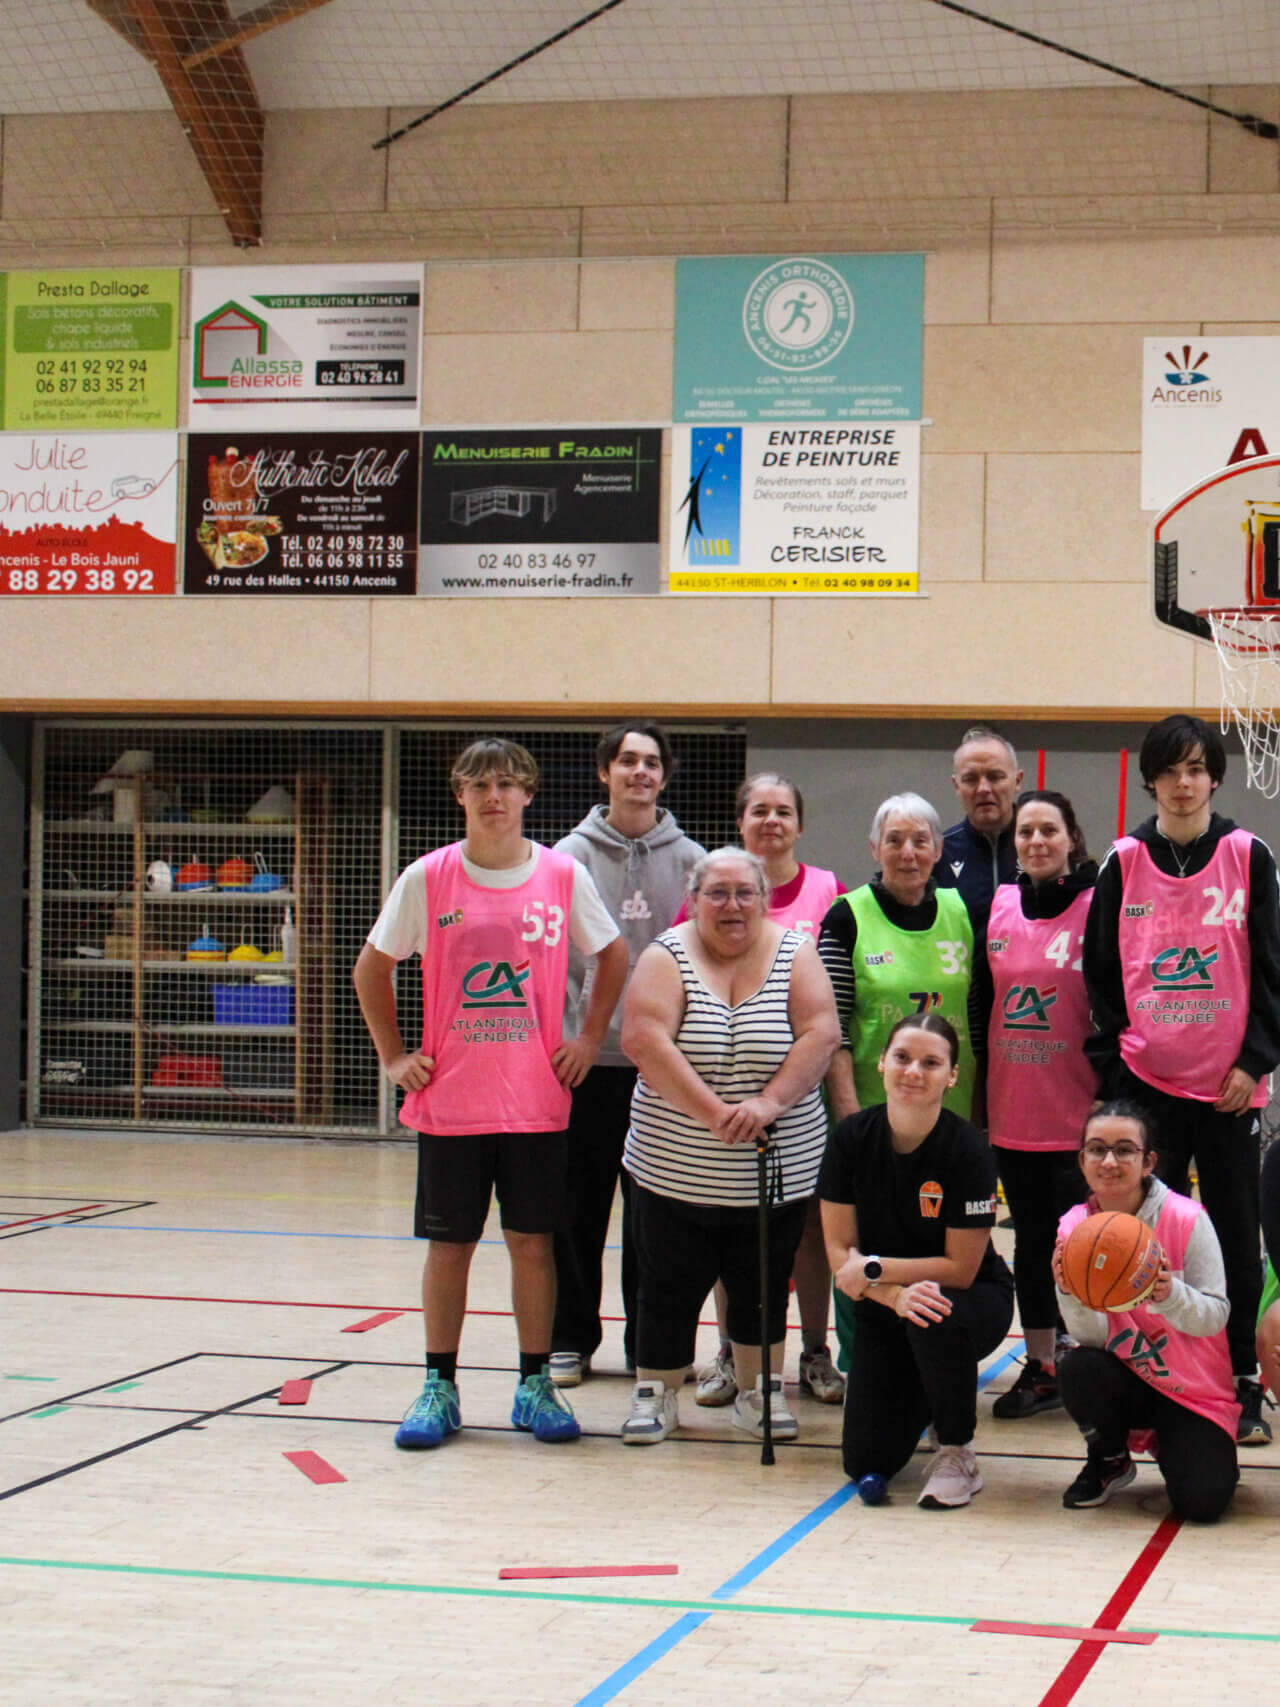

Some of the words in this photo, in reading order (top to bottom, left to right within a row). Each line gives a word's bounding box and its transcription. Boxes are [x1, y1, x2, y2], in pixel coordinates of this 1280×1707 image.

[38, 281, 85, 297] Presta
[90, 280, 150, 298] Dallage
[270, 297, 300, 307] VOTRE
[304, 297, 354, 307] SOLUTION
[36, 360, 54, 375] 02
[60, 360, 77, 374] 41
[83, 359, 101, 374] 92
[106, 359, 124, 374] 92
[129, 359, 147, 373] 94
[231, 357, 303, 374] Allassa
[36, 379, 54, 393] 06
[59, 378, 77, 393] 87
[82, 378, 101, 392] 83
[106, 378, 124, 392] 35
[128, 377, 145, 392] 21
[321, 371, 335, 385] 02
[337, 371, 350, 384] 40
[353, 371, 367, 384] 96
[369, 371, 383, 384] 28
[385, 371, 398, 383] 41
[1151, 386, 1223, 403] Ancenis
[768, 430, 896, 446] ENTREPRISE
[14, 438, 88, 470] Julie
[762, 451, 790, 467] DE
[796, 451, 901, 467] PEINTURE
[330, 447, 409, 496] Kebab
[582, 473, 632, 483] Menuiserie
[574, 484, 632, 495] Agencement
[203, 498, 242, 512] Ouvert
[793, 526, 865, 541] FRANCK
[307, 535, 323, 551] 02
[327, 535, 344, 551] 40
[348, 535, 364, 551] 98
[368, 535, 384, 551] 72
[388, 535, 404, 551] 30
[52, 553, 67, 566] Le
[71, 552, 100, 566] Bois
[103, 552, 140, 566] Jauni
[307, 554, 323, 568] 06
[327, 554, 343, 568] 06
[348, 554, 363, 568] 98
[369, 554, 383, 568] 11
[387, 554, 403, 568] 55
[478, 554, 497, 569] 02
[503, 554, 522, 569] 40
[527, 554, 546, 569] 83
[552, 554, 572, 569] 46
[577, 554, 596, 569] 97
[771, 546, 887, 563] CERISIER
[9, 569, 39, 591] 88
[47, 569, 78, 591] 29
[85, 569, 115, 591] 38
[123, 569, 154, 591] 92
[205, 575, 220, 587] 49
[223, 575, 240, 587] rue
[244, 575, 265, 587] des
[268, 575, 301, 587] Halles
[312, 575, 350, 587] 44150
[352, 575, 397, 587] Ancenis
[442, 573, 634, 588] www.menuiserie-fradin.fr
[824, 578, 838, 588] 02
[842, 578, 856, 588] 40
[1125, 907, 1145, 917] BASK
[1202, 886, 1247, 930] 24
[521, 901, 564, 948] 53
[1136, 999, 1231, 1011] ATLANTIQUE
[965, 1200, 992, 1216] BASK
